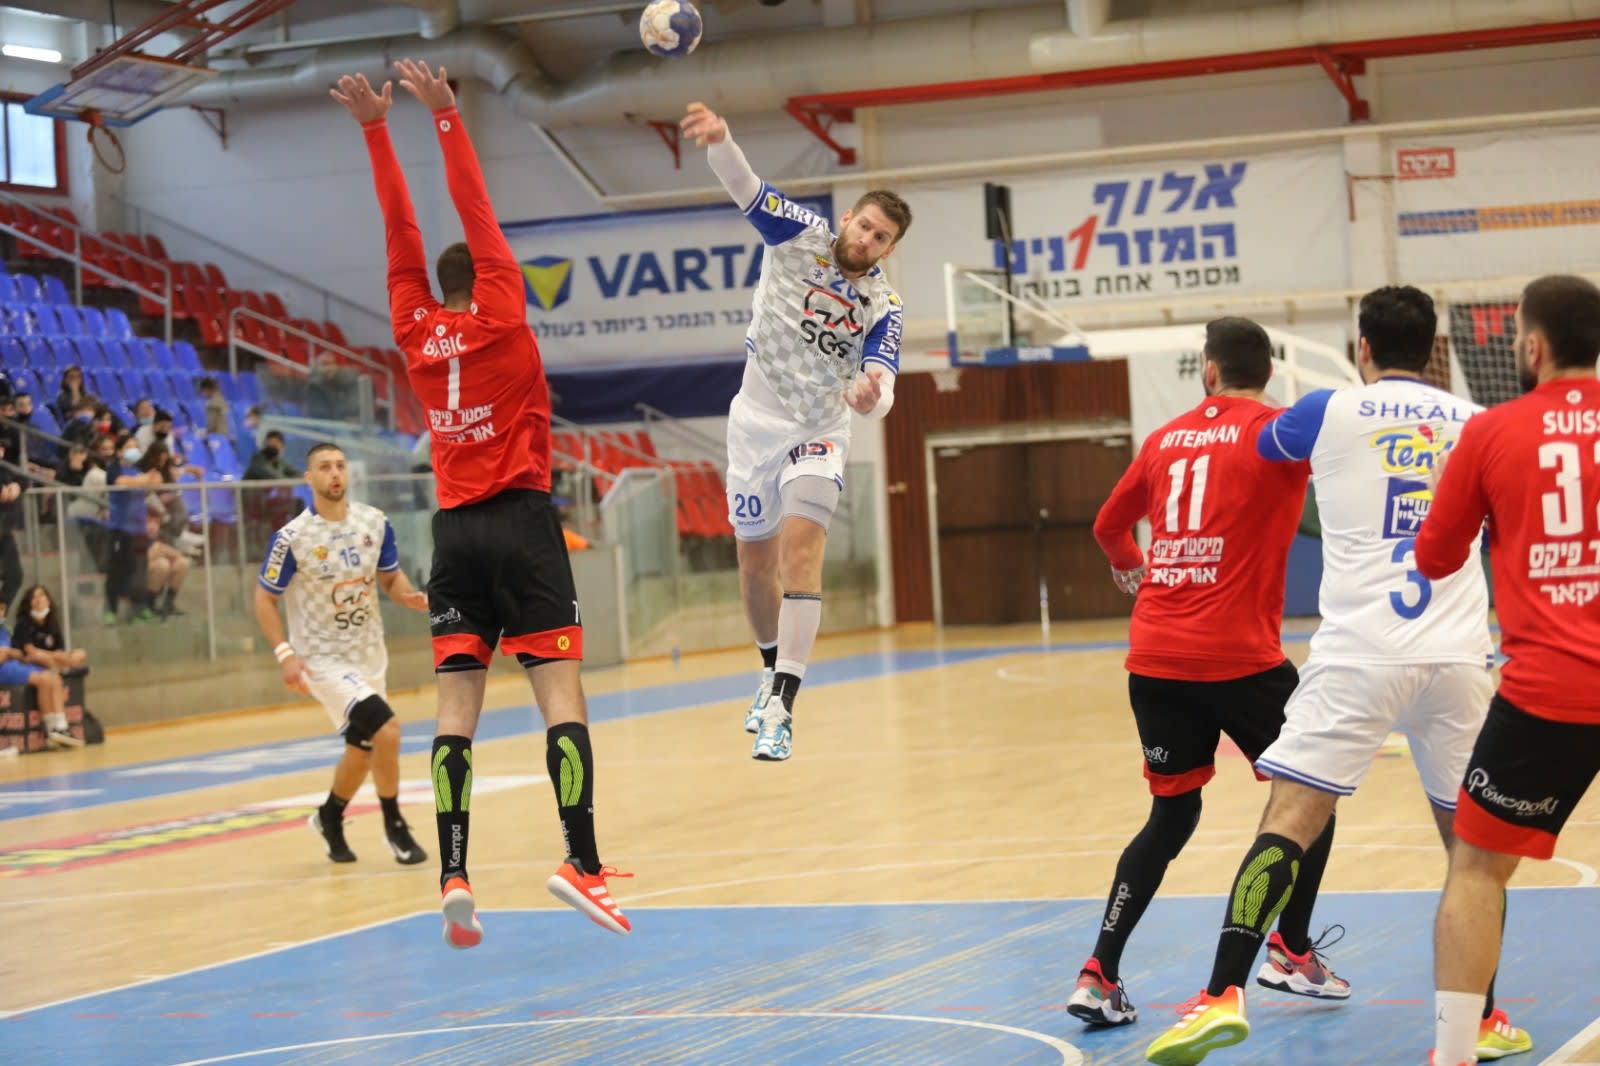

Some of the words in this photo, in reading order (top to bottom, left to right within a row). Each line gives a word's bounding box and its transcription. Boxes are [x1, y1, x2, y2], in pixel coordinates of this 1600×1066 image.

[1093, 162, 1247, 227] אלוף
[1095, 272, 1152, 295] אחת
[1165, 266, 1240, 289] מספר
[592, 316, 647, 335] ביותר
[652, 311, 715, 330] הנמכר
[448, 356, 460, 411] 1
[1358, 400, 1476, 423] SHKAL
[1543, 410, 1600, 435] SUIS
[734, 493, 762, 518] 20
[1166, 454, 1211, 533] 11
[270, 528, 296, 567] VARTA
[339, 546, 361, 568] 15
[1389, 537, 1433, 620] 3
[447, 824, 461, 868] Kempa
